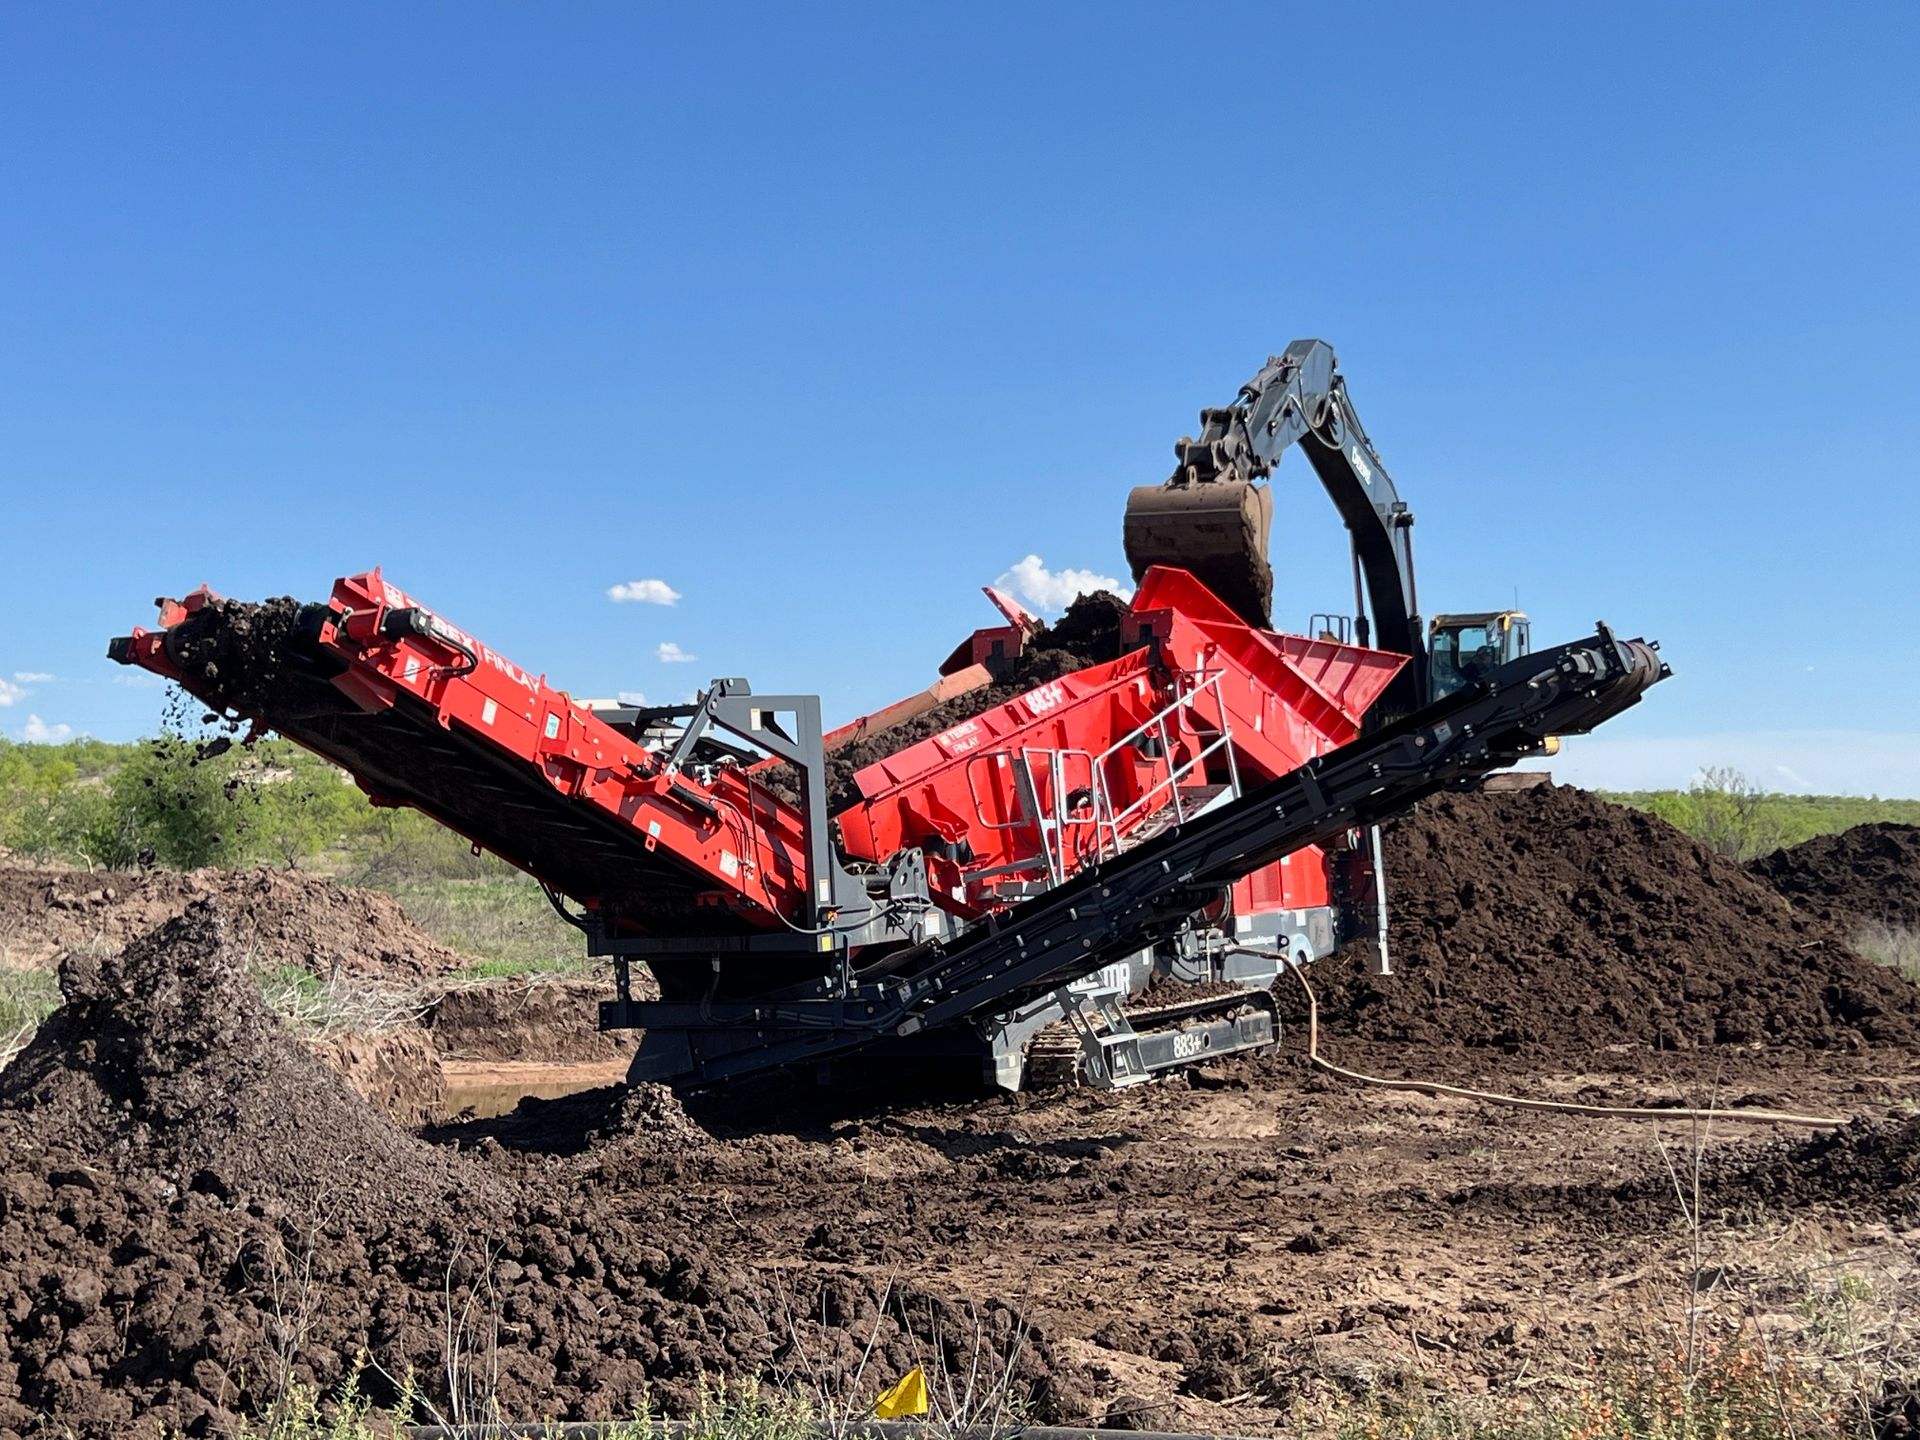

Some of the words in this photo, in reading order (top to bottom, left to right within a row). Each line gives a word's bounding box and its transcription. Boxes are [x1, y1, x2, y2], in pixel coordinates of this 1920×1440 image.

[483, 647, 541, 695] FINLAY
[1025, 681, 1062, 714] 883+
[1173, 1033, 1201, 1058] 883+
